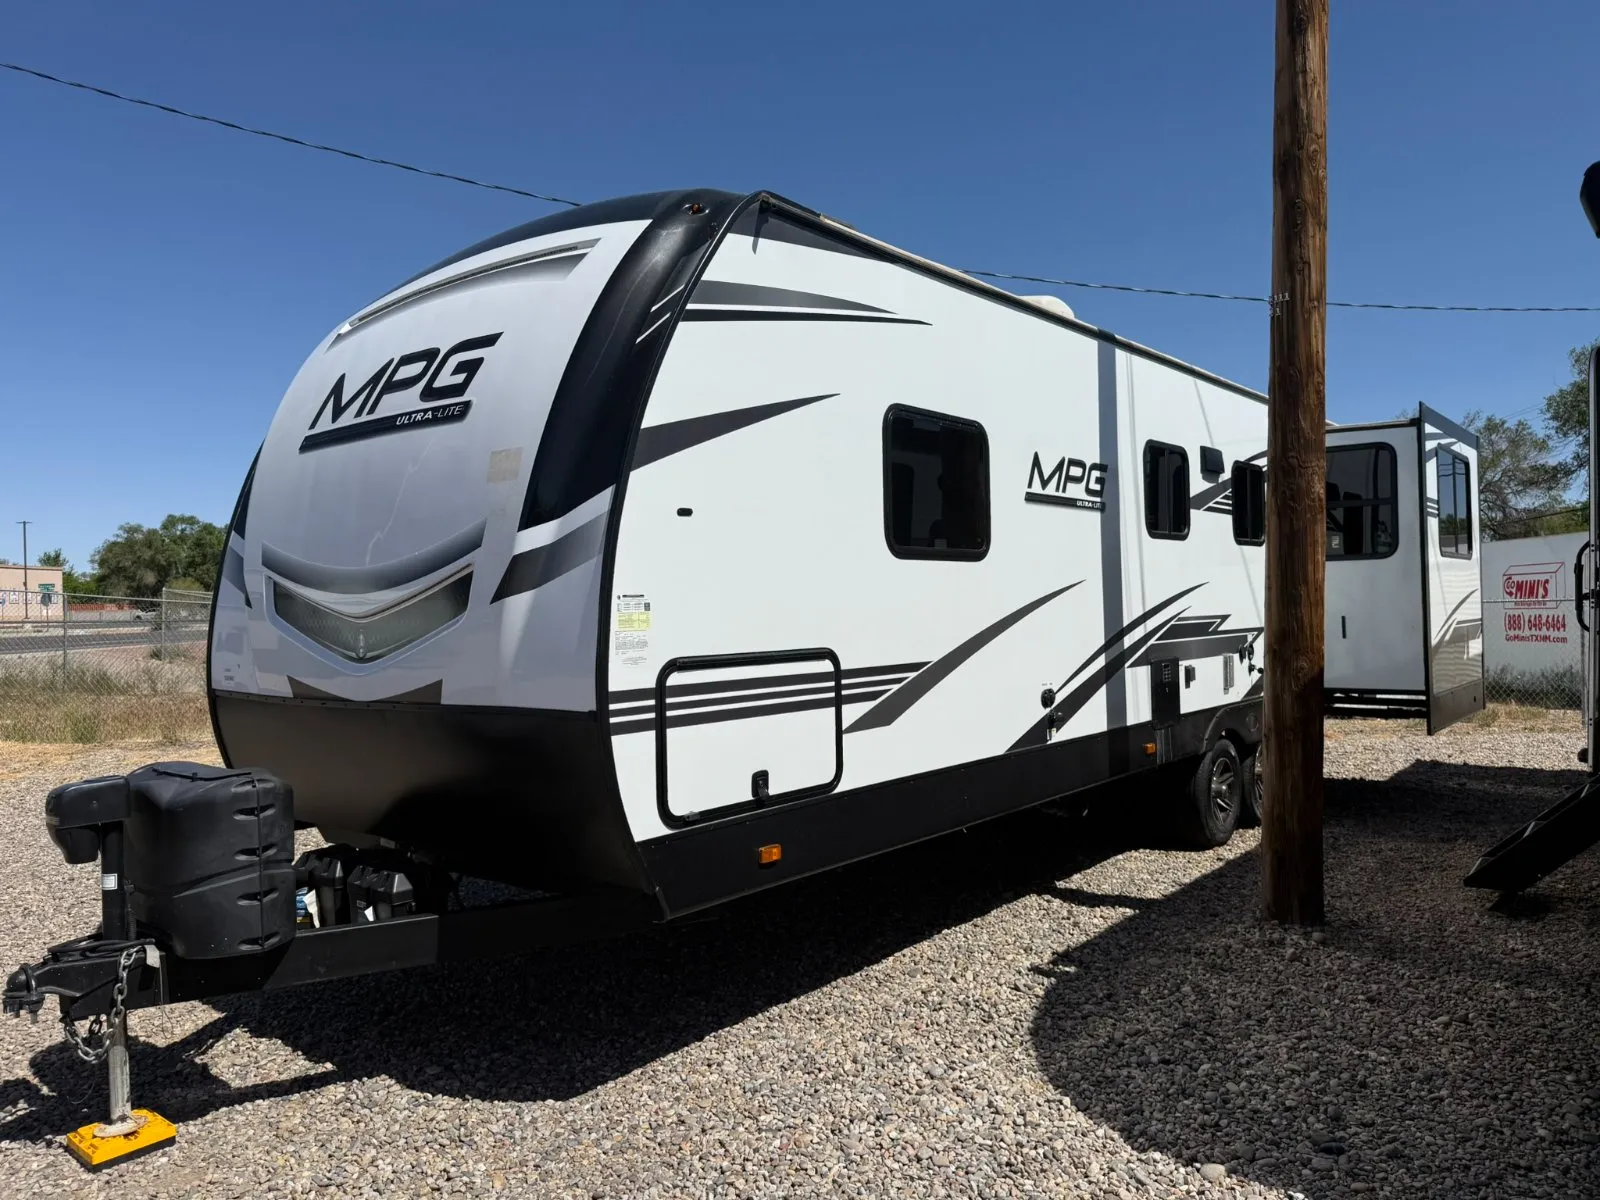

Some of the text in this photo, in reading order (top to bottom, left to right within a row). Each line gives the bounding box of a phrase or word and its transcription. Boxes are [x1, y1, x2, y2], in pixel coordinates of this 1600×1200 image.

[308, 331, 504, 430] MPG
[396, 404, 464, 425] ULTRA-LITE
[1027, 451, 1108, 499] MPG
[1514, 579, 1549, 599] MINI'S
[1504, 611, 1567, 633] (888) 648-6464
